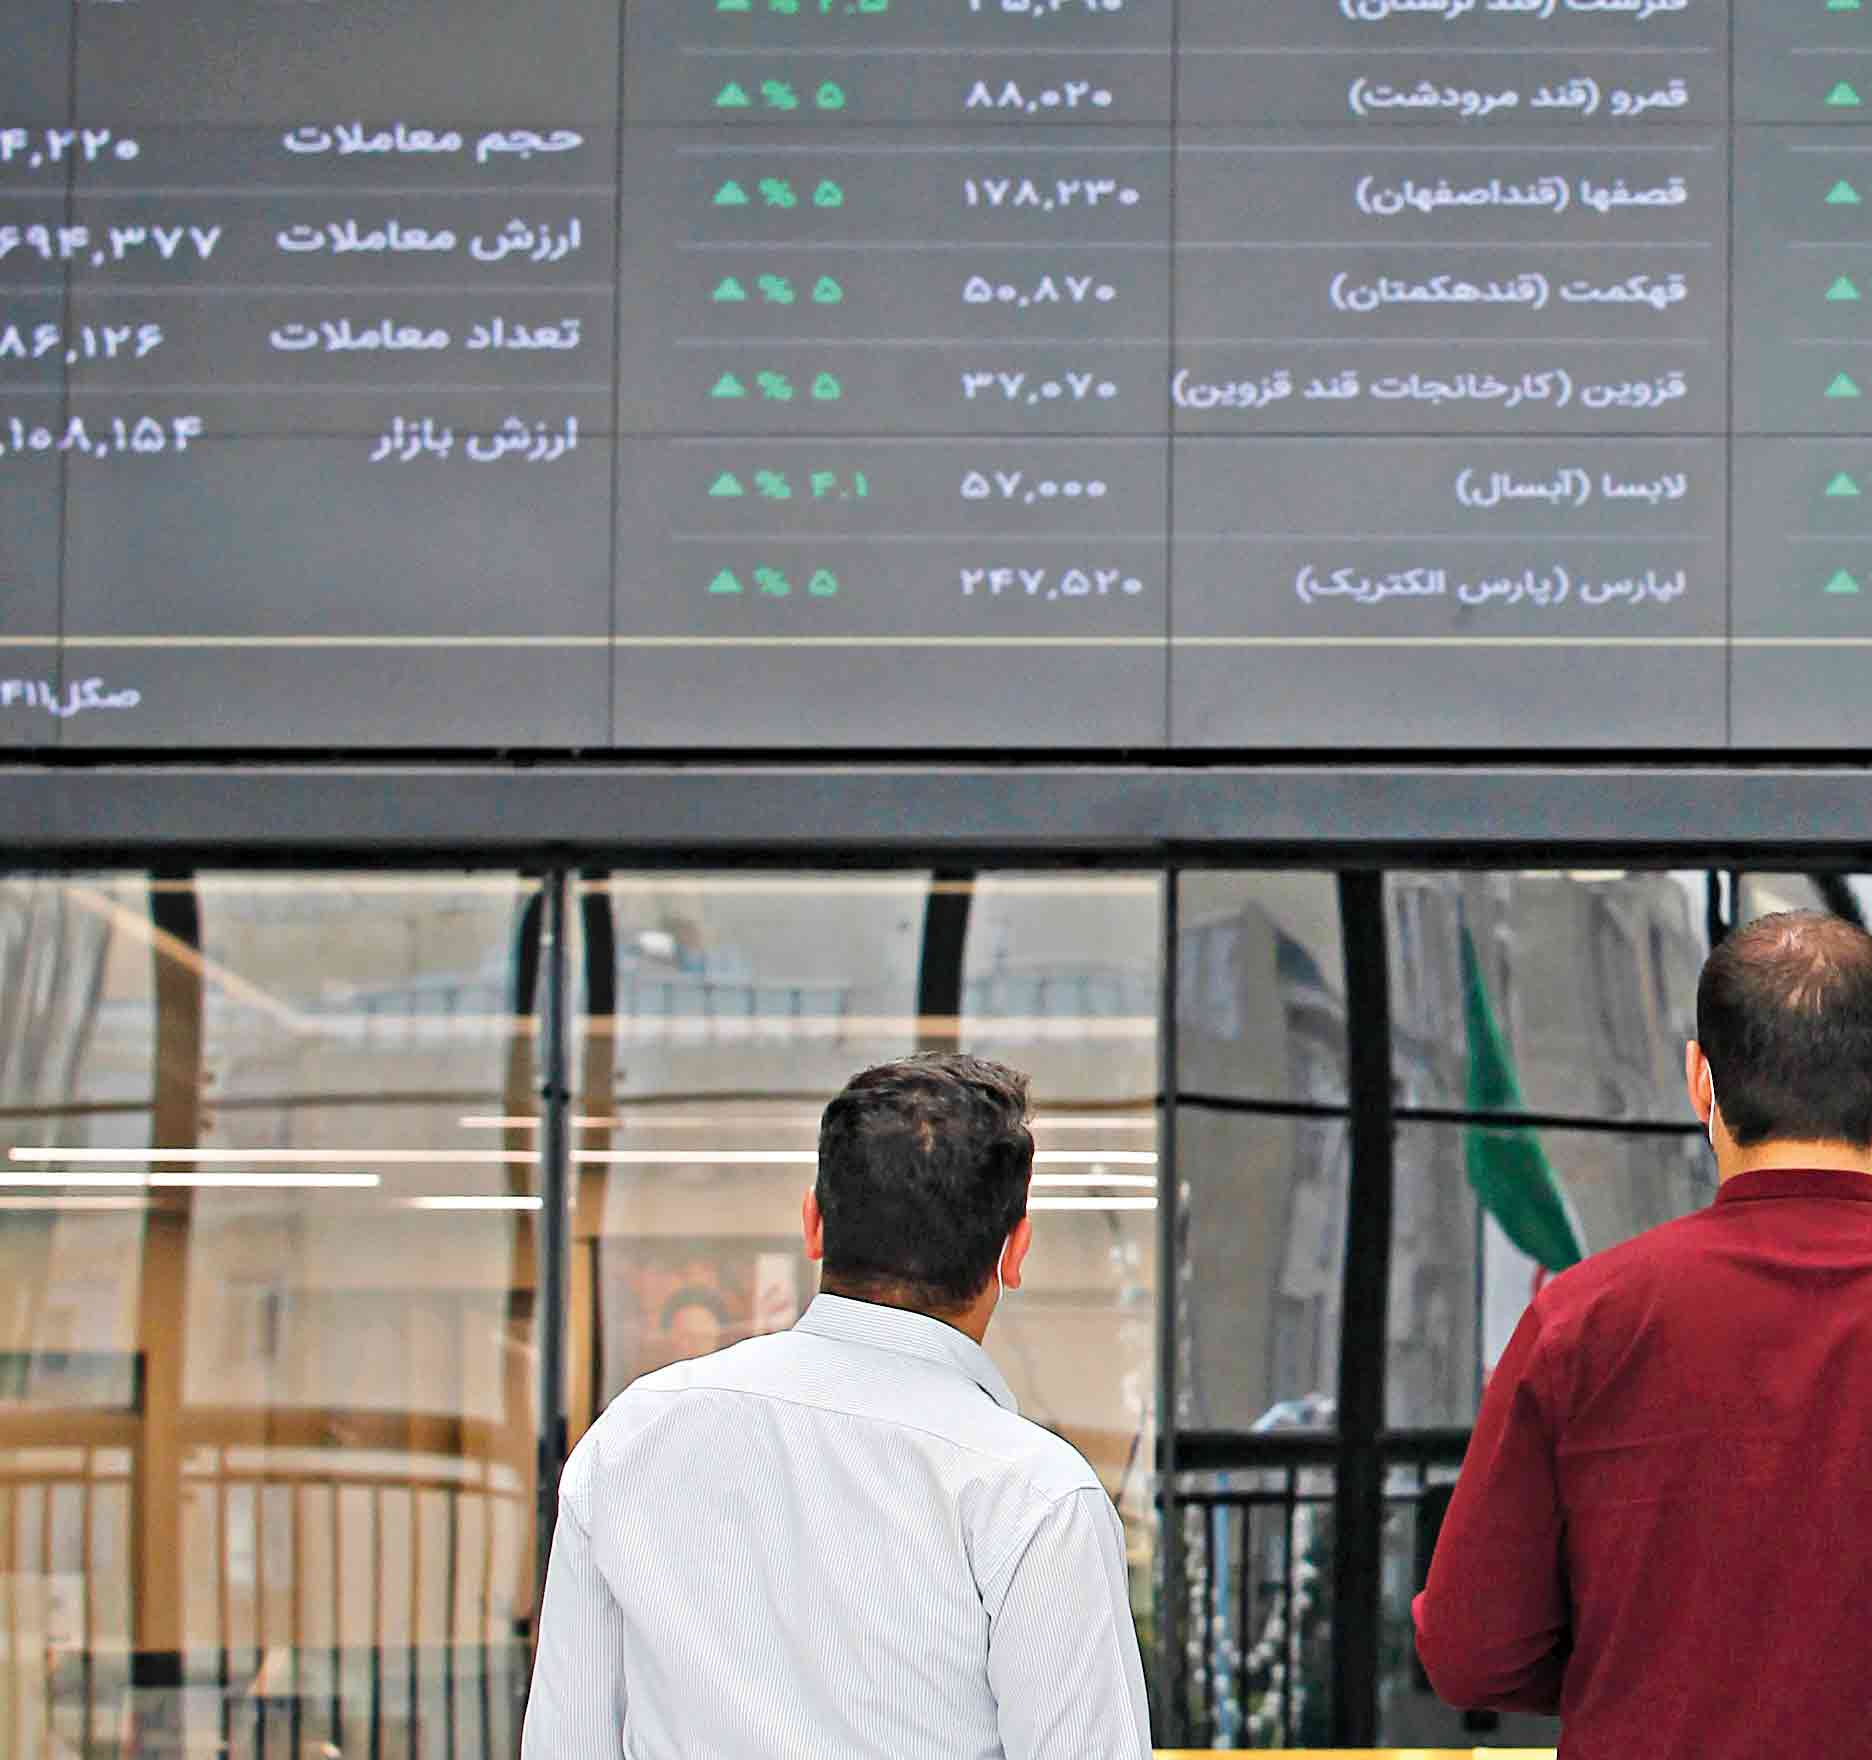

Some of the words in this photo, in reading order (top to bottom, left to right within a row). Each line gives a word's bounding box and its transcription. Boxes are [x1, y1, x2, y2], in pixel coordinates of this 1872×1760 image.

[815, 79, 847, 111] ۵
[1348, 77, 1519, 116] مرودشت)
[1530, 77, 1600, 115] (قند
[1609, 79, 1689, 116] قمرو
[283, 121, 462, 155] معاملات
[476, 130, 584, 163] حجم
[811, 177, 845, 209] ۵
[1356, 175, 1570, 215] (قنداصفهان)
[1577, 176, 1688, 213] قصفها
[276, 219, 457, 257] معاملات
[470, 218, 581, 261] ارزش
[813, 275, 843, 305] ۵
[1328, 272, 1549, 311] (قندهکمتان)
[1559, 274, 1687, 310] قهکمت
[269, 319, 450, 351] معاملات
[466, 317, 580, 349] تعداد
[814, 371, 842, 401] ۵
[1173, 369, 1292, 409] قزوین)
[1303, 371, 1360, 398] قند
[1370, 370, 1572, 407] (کارخانجات
[1581, 372, 1687, 407] قزوین
[371, 416, 453, 462] بازار
[466, 415, 578, 461] ارزش
[1456, 469, 1591, 507] (آبسال)
[1602, 473, 1687, 503] لابسا
[807, 569, 838, 597] ۵
[1295, 566, 1446, 603] الکتریک)
[1458, 567, 1569, 604] (پارس
[1579, 571, 1686, 604] لپارس
